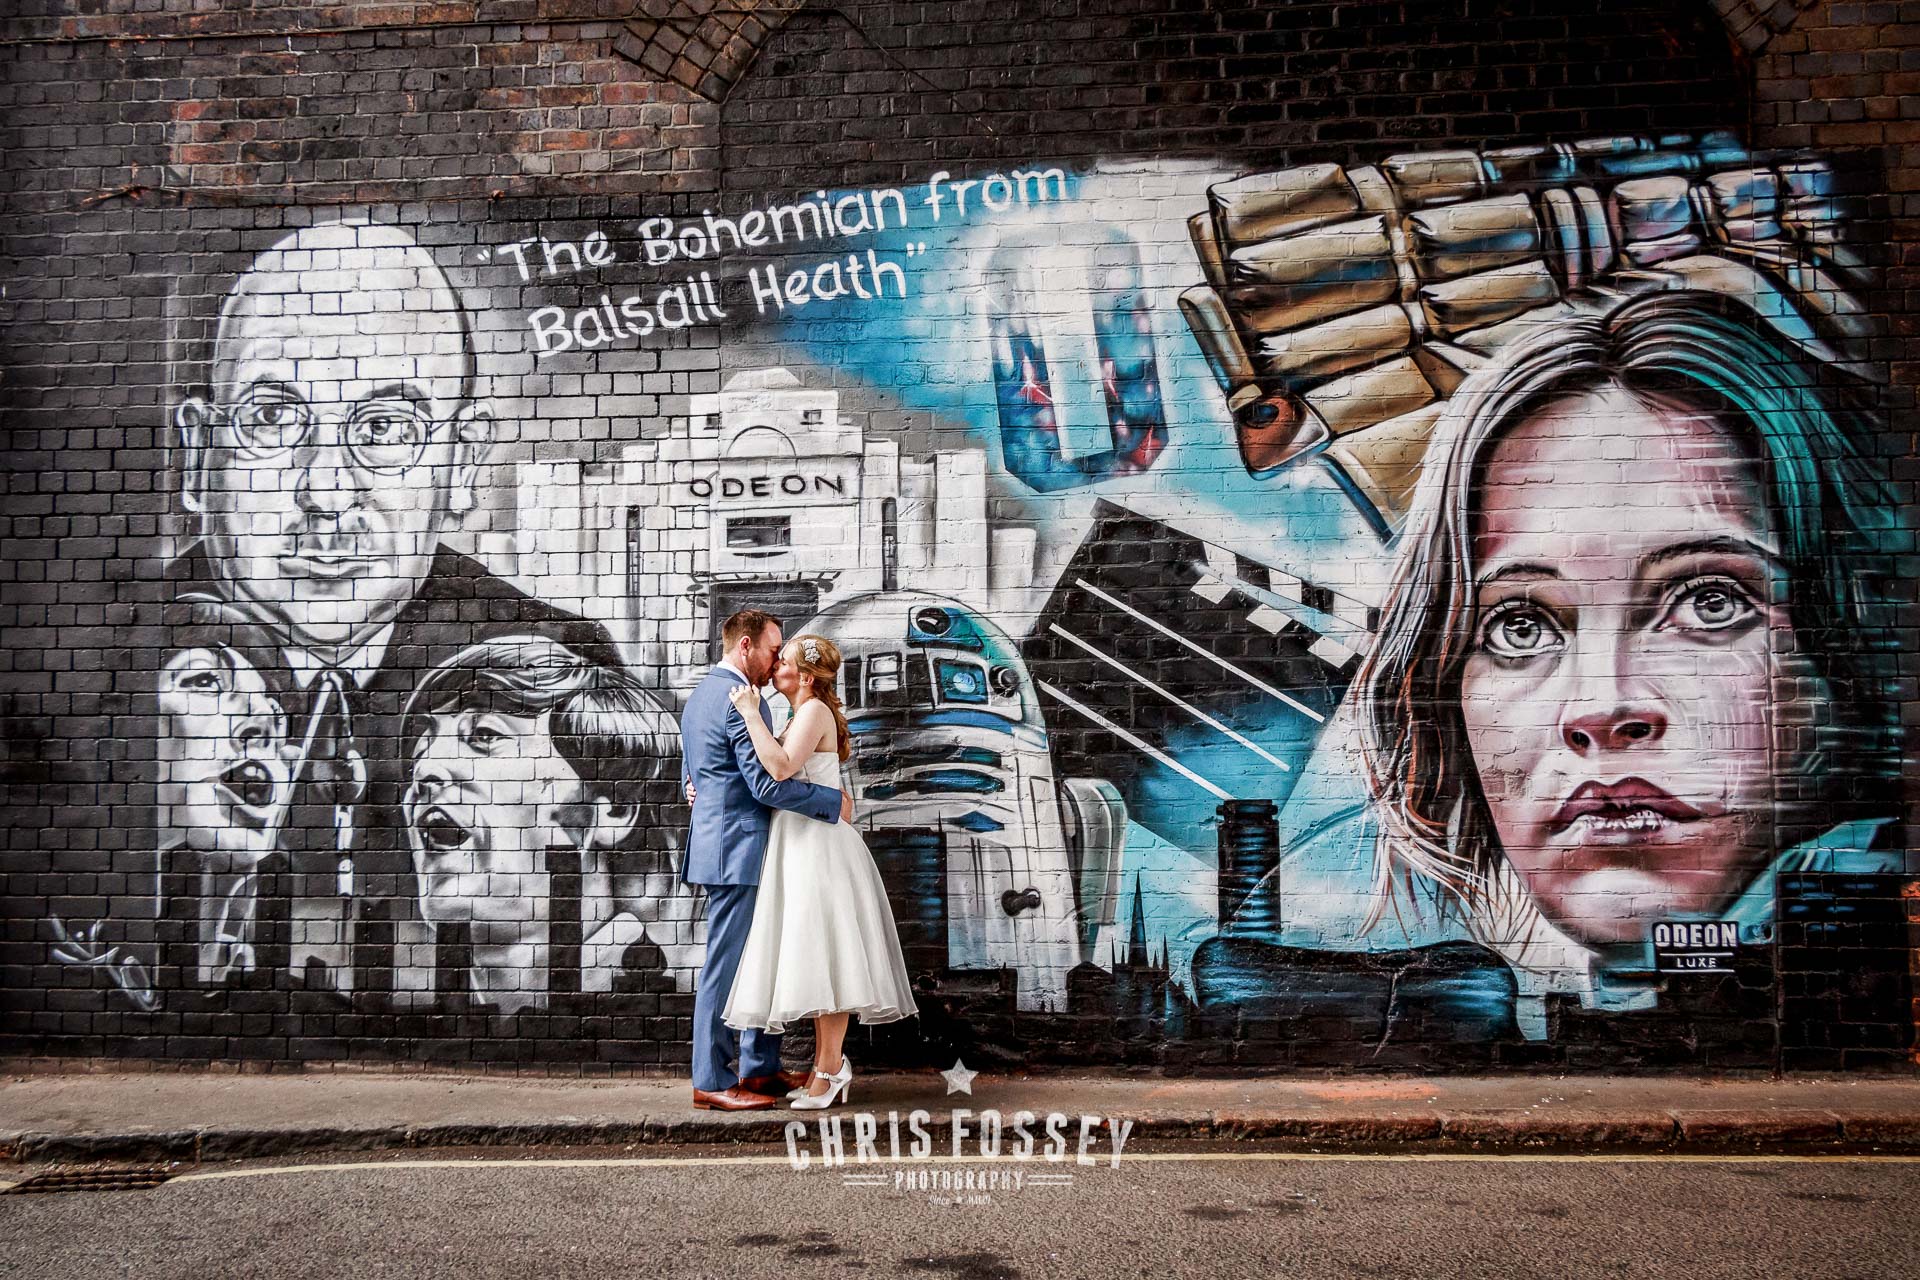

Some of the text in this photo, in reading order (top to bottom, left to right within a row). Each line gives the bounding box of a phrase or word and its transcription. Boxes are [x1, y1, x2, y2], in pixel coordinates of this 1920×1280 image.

[637, 187, 908, 267] Bohemian
[923, 167, 1067, 222] from
[527, 271, 727, 358] Balsall
[689, 474, 843, 498] ODEON
[1654, 923, 1738, 948] ODEON
[1676, 957, 1717, 968] LUXE
